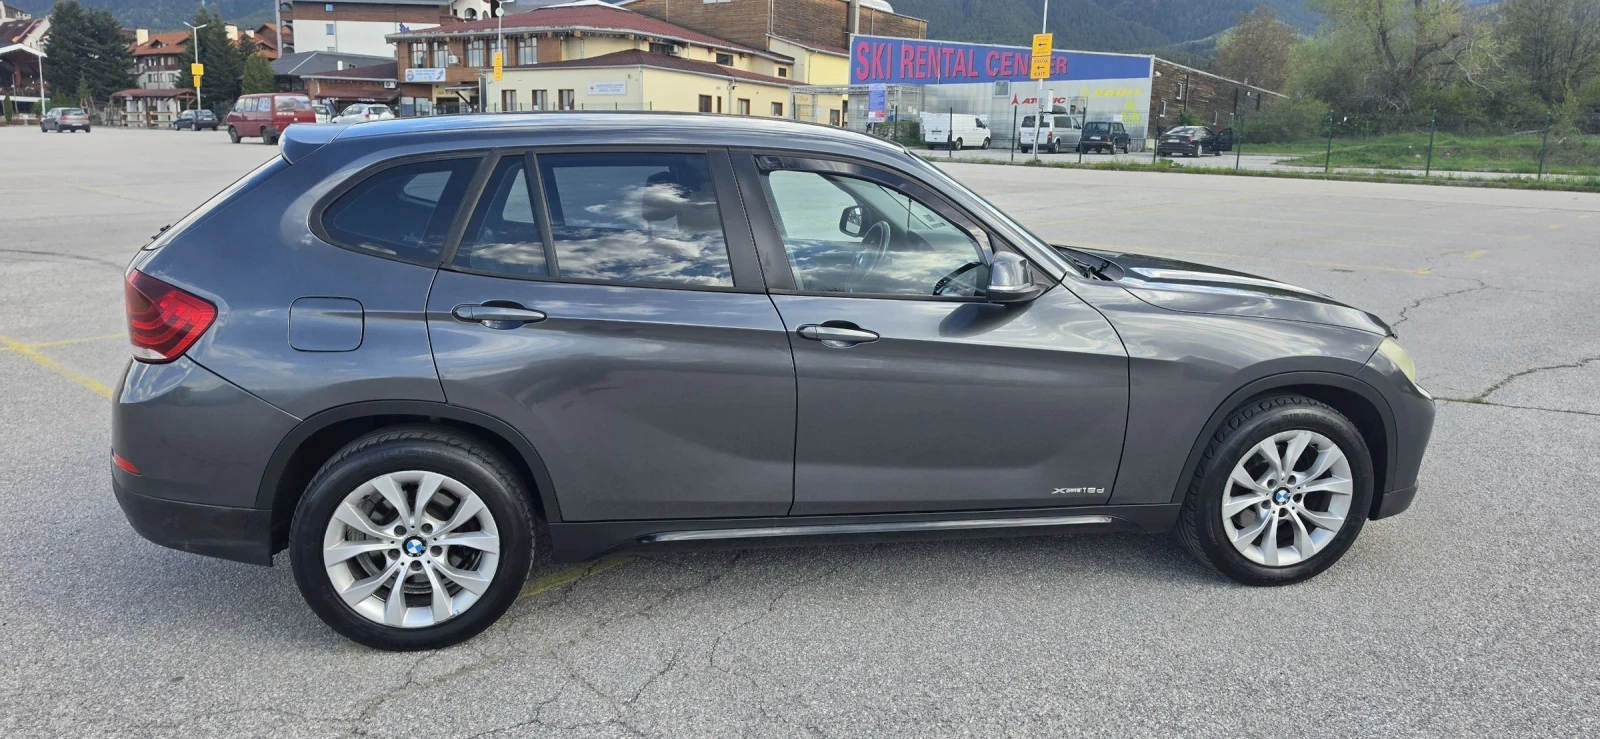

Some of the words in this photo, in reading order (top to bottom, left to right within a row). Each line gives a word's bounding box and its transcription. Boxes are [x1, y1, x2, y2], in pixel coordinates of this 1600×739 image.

[856, 41, 893, 81] SKI
[899, 44, 979, 80] RENTAL
[986, 51, 1067, 77] CENER
